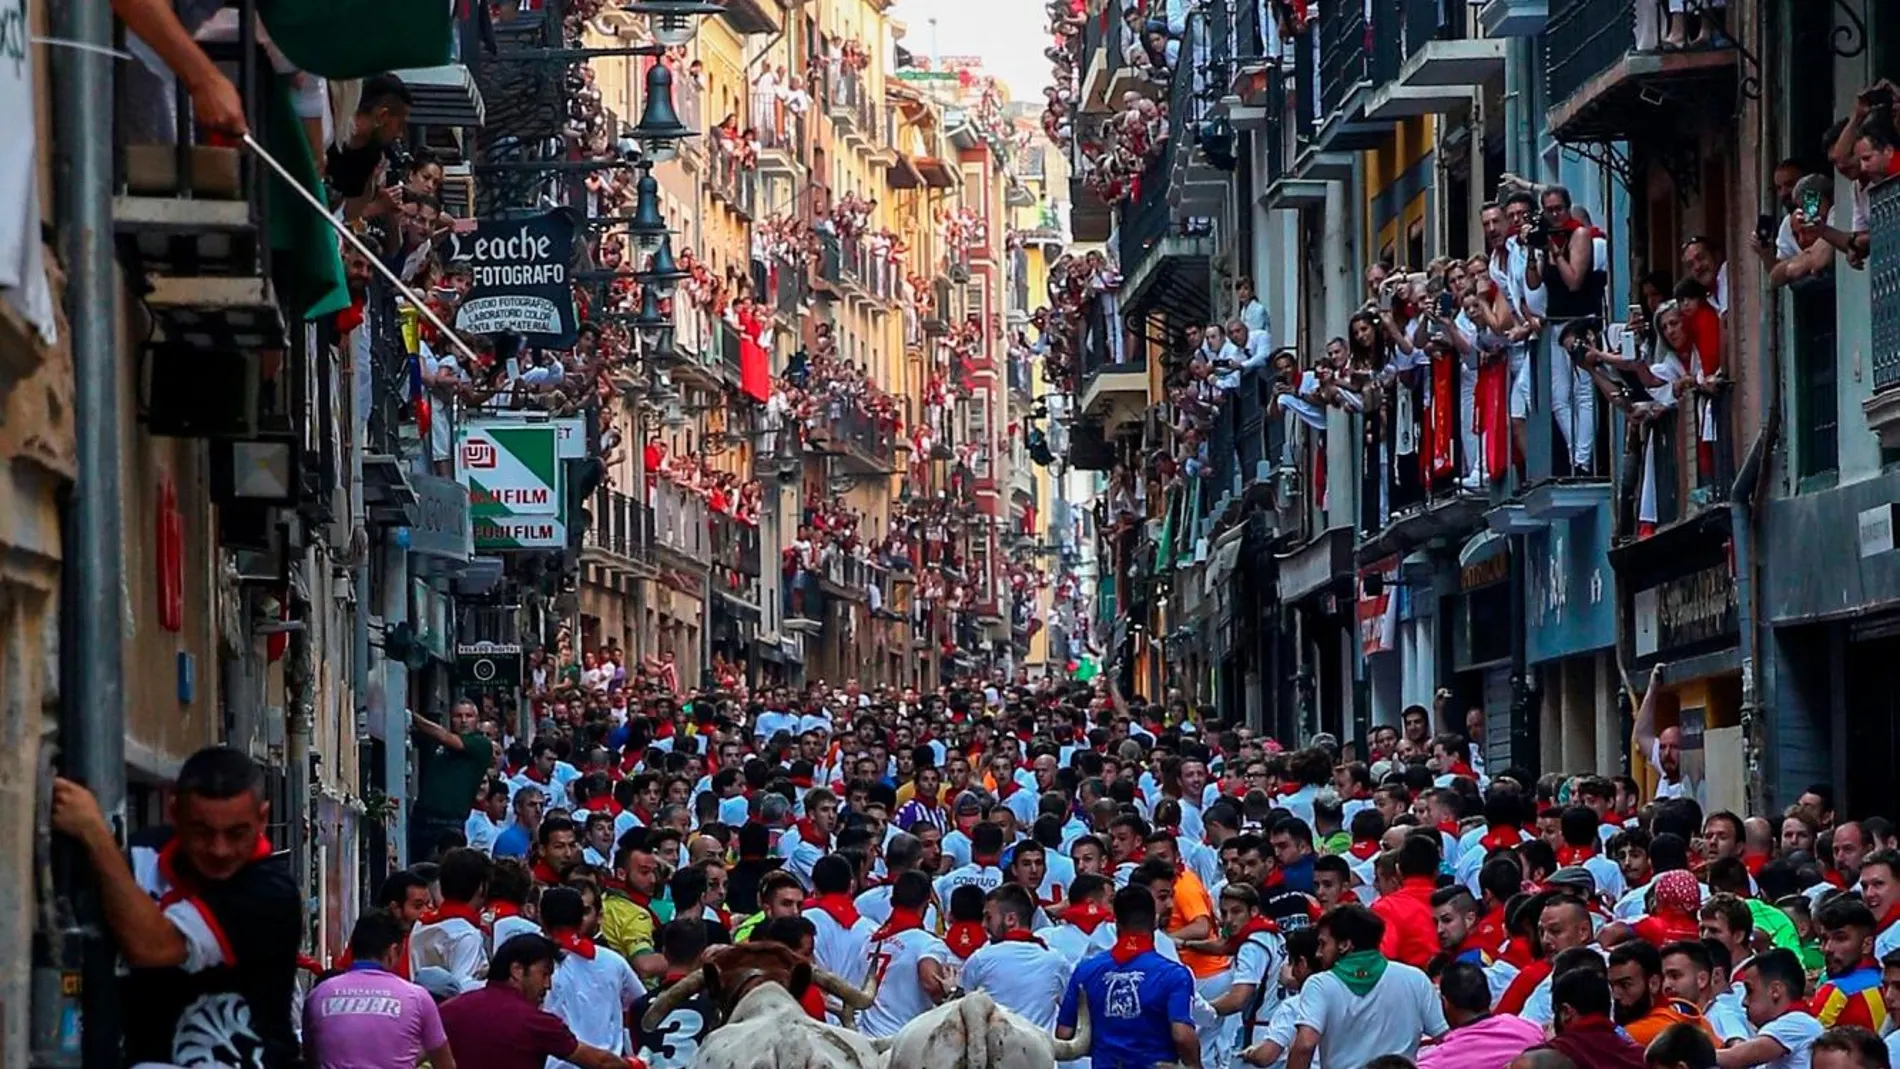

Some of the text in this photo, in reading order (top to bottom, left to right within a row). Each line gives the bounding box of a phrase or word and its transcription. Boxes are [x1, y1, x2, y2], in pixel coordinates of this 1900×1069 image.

[451, 225, 551, 261] Leache
[473, 264, 564, 286] FOTOGRAFO
[463, 300, 497, 314] ESTUDIO
[468, 309, 552, 322] LABORATORIO COLOR
[467, 322, 490, 333] ENTA
[509, 320, 551, 331] MATERIAL
[650, 1008, 704, 1069] 3
